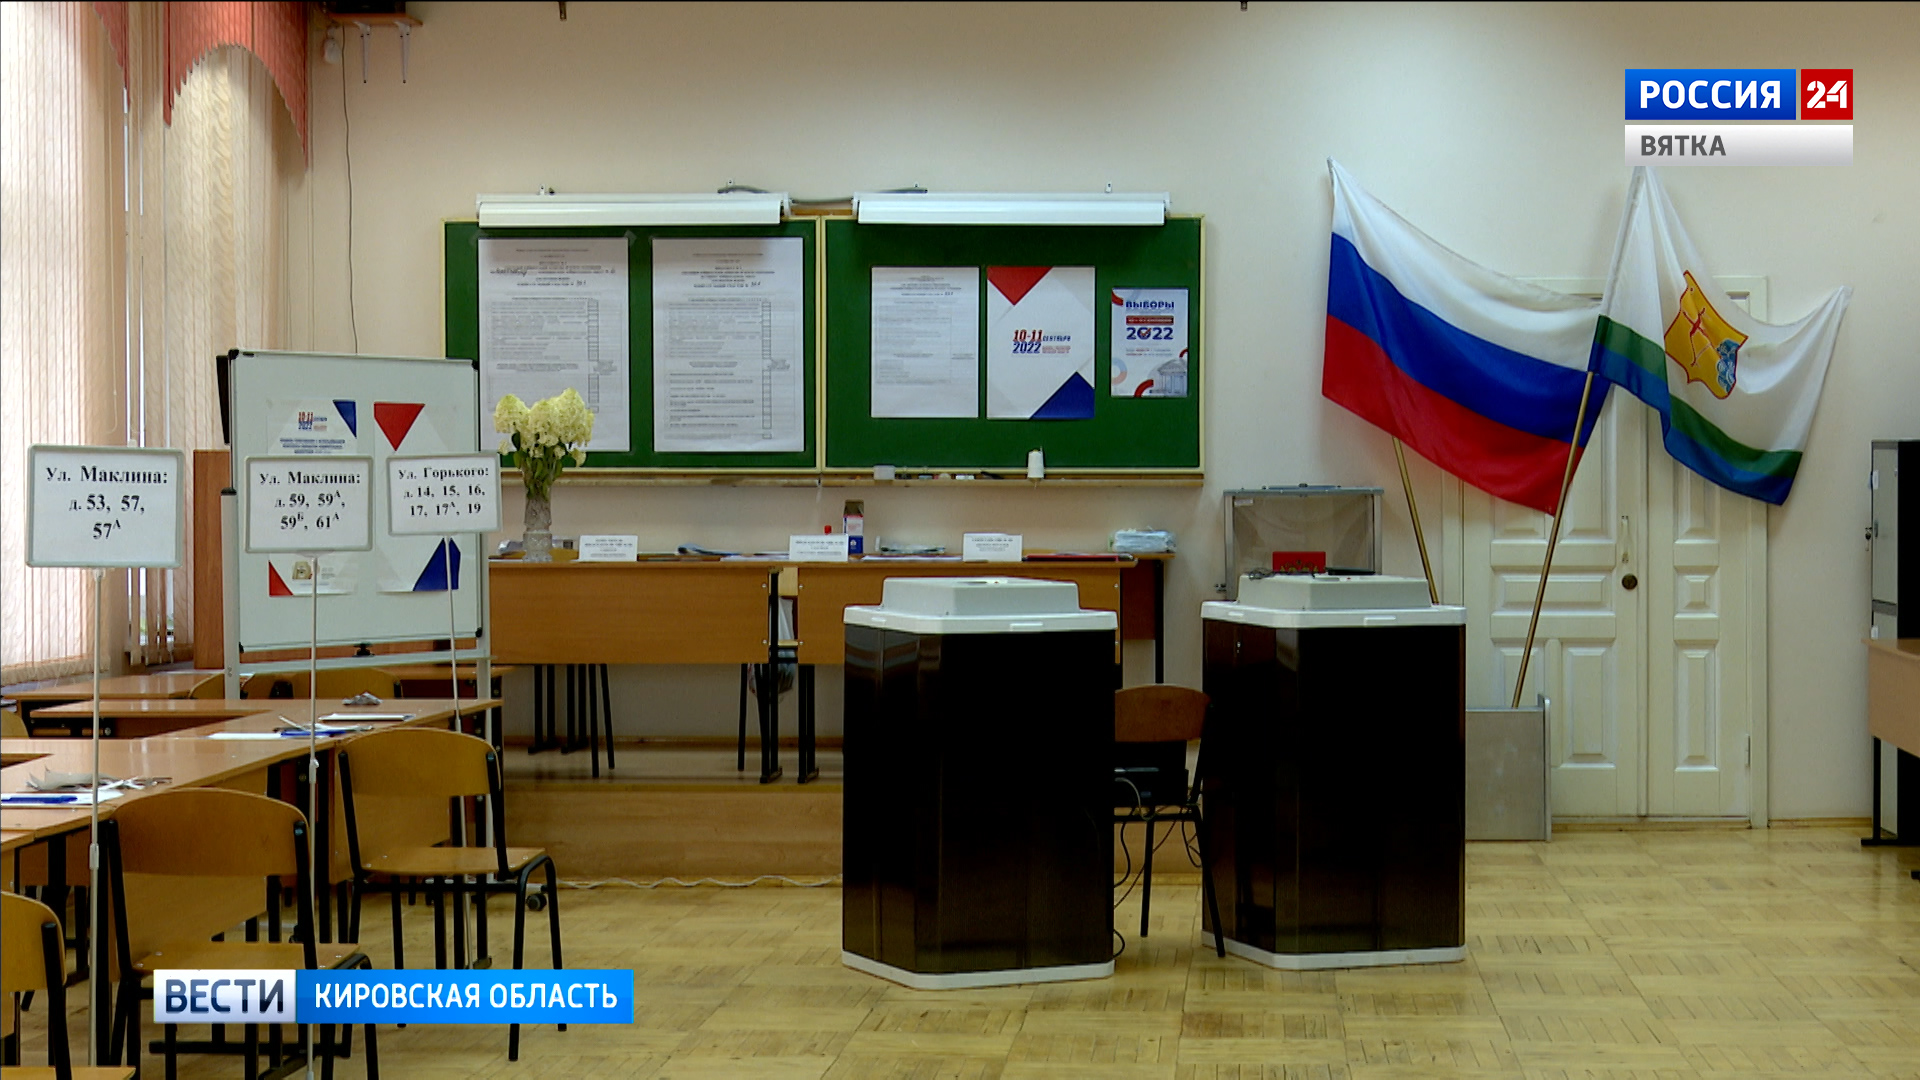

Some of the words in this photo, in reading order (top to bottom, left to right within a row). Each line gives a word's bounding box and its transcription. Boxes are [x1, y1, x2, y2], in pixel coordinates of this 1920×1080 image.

[1125, 301, 1175, 309] ВЫБОРЫ
[1012, 329, 1043, 342] 10-11
[1126, 326, 1174, 340] 2022
[1012, 341, 1042, 354] 2022
[46, 467, 71, 482] Ул.
[80, 465, 168, 483] Маклина:
[260, 473, 280, 485] Ул.
[288, 471, 361, 484] Маклина:
[398, 469, 417, 480] Ул.
[423, 467, 489, 481] Горького:
[403, 490, 413, 499] д.
[417, 486, 435, 498] 14,
[443, 485, 460, 497] 15,
[468, 484, 485, 496] 16,
[68, 499, 82, 511] д.
[86, 493, 111, 513] 53,
[121, 495, 145, 515] 57,
[274, 499, 286, 508] д.
[289, 493, 310, 508] 59,
[411, 505, 428, 517] 17,
[468, 503, 481, 514] 19
